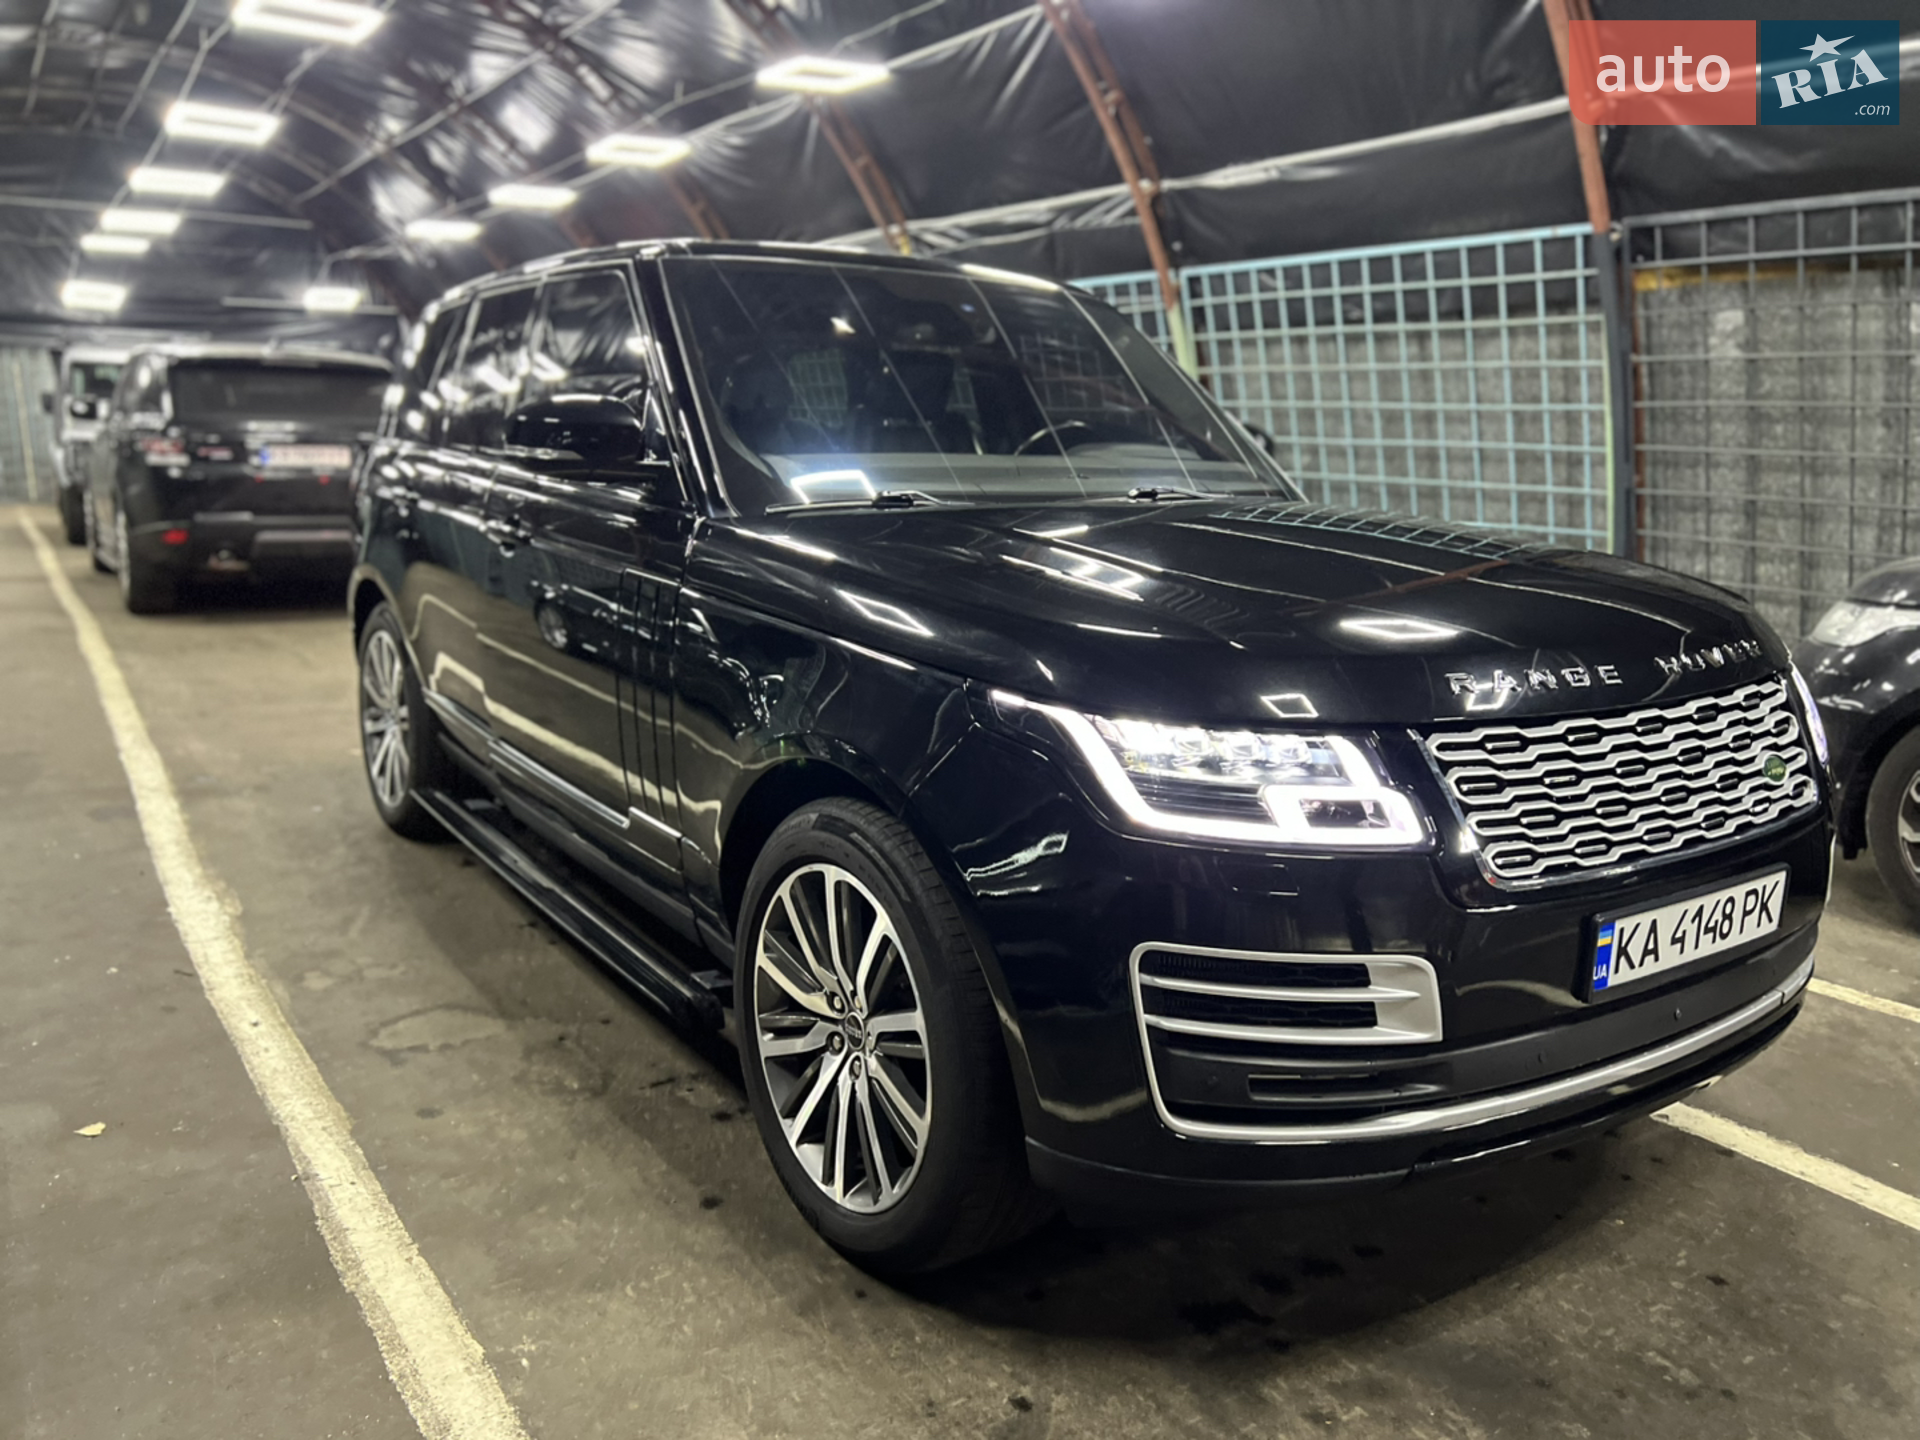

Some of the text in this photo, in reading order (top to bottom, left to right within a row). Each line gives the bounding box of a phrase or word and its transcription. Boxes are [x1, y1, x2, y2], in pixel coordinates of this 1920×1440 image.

[1444, 664, 1623, 695] RANGE
[1613, 880, 1780, 975] KA 4148 PK
[1593, 964, 1608, 980] UA
